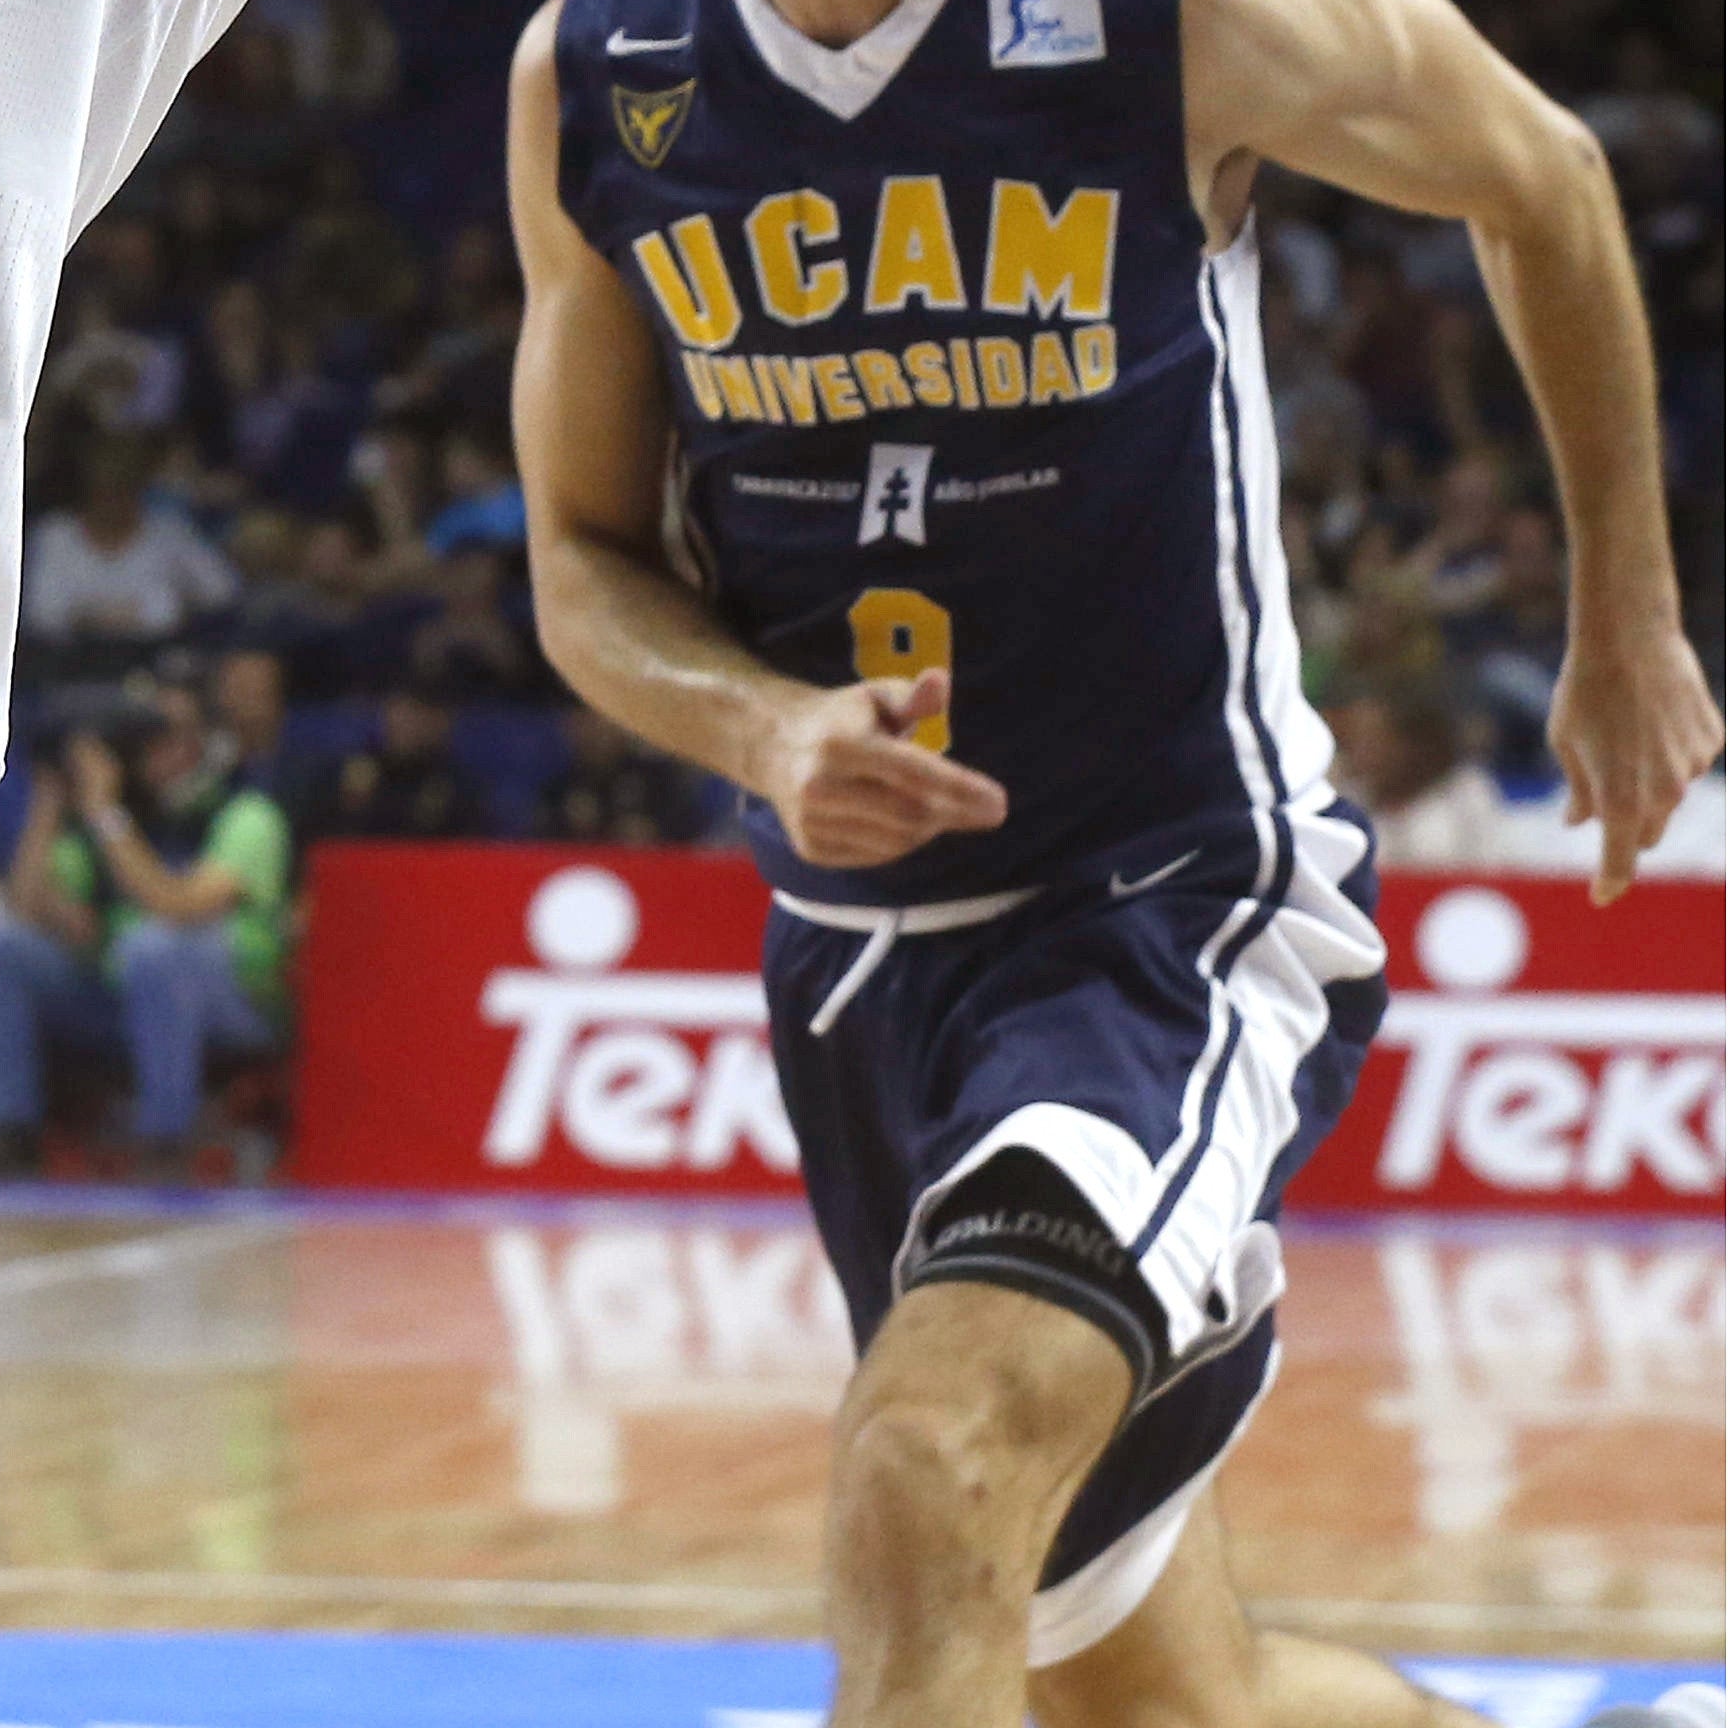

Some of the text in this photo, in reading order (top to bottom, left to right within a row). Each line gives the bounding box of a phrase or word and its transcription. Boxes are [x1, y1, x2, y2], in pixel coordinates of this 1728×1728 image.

[632, 174, 1121, 352] UCAM
[682, 323, 1117, 428] UNIVERSIDAD
[480, 969, 801, 1170] Tek
[1372, 994, 1728, 1194] Tek
